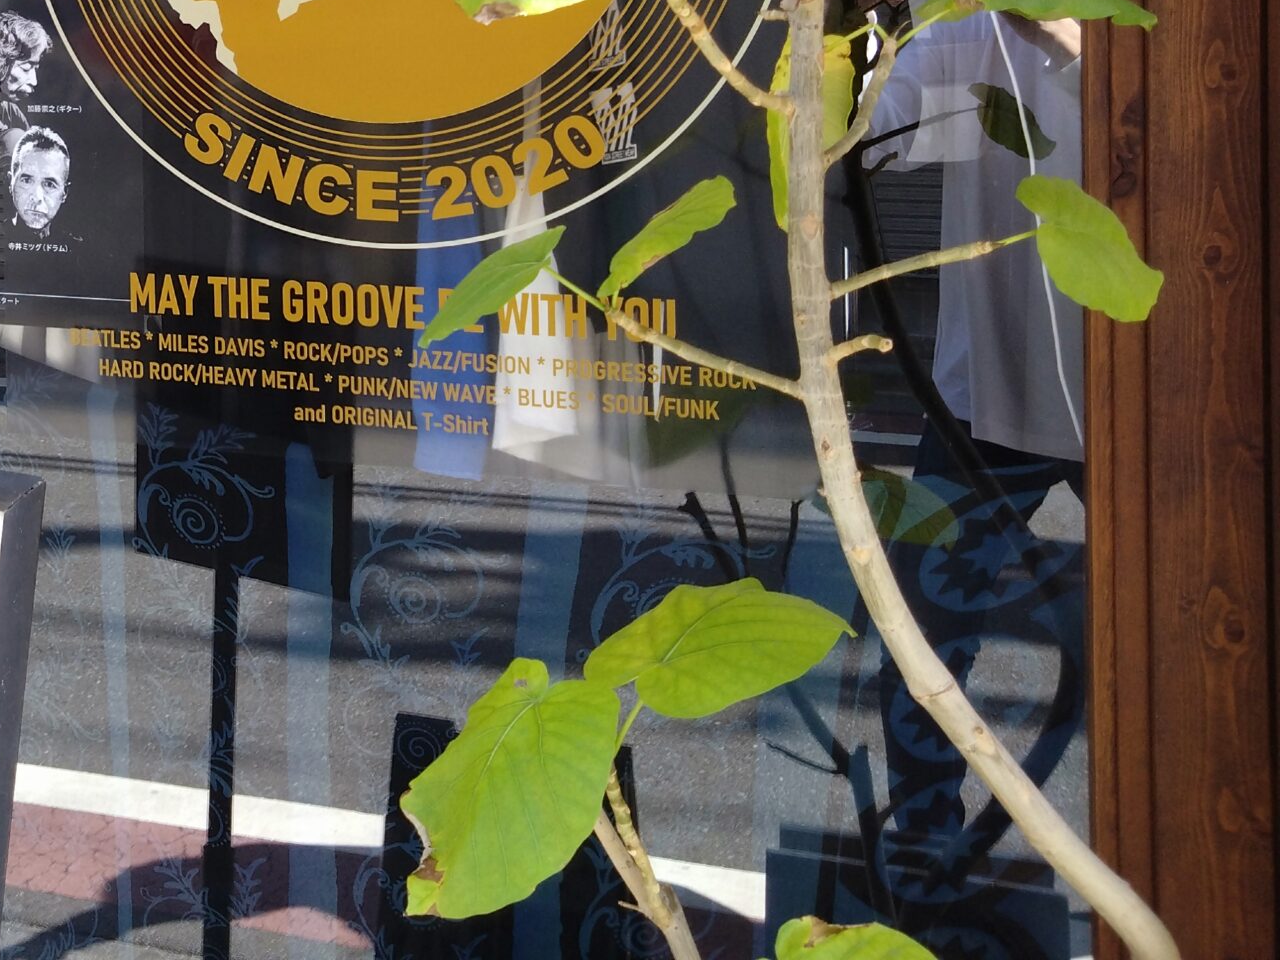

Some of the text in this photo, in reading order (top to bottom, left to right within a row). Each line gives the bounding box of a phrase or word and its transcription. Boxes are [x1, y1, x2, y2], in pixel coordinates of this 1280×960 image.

[183, 113, 607, 221] SINCE 2020
[129, 272, 199, 316] MAY
[208, 276, 270, 321] THE
[282, 279, 425, 330] GROOVE
[498, 292, 587, 339] WITH
[70, 327, 141, 350] BEATLES
[158, 333, 209, 354] MILES
[214, 337, 265, 358] DAVIS
[284, 342, 389, 366] ROCK/POPS
[408, 349, 530, 375] JAZZ/FUSION
[552, 358, 698, 387] PROGRESSIVE
[99, 359, 720, 421] HARD ROCK/HEAVY METAL PUNK/NEW WAVE BLUES SOUL/FUNK
[294, 405, 489, 436] and ORIGINAL T-Shirt
